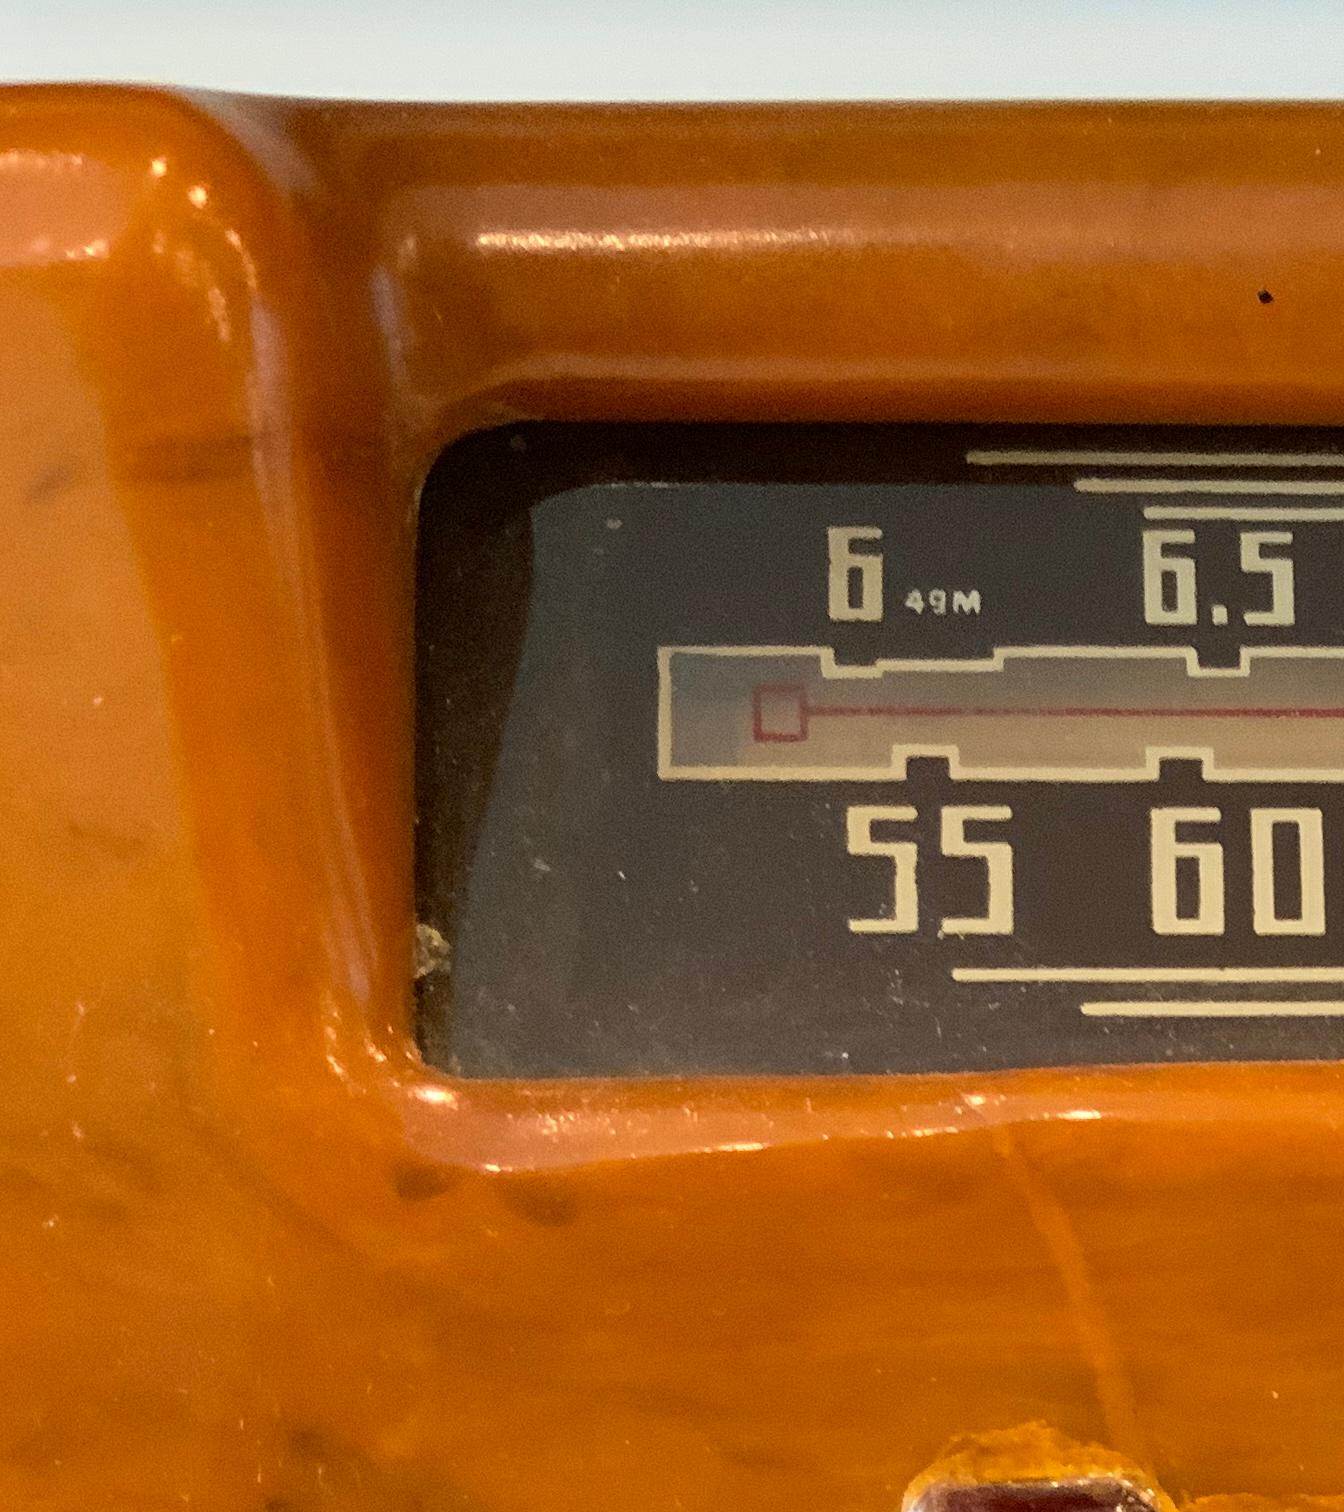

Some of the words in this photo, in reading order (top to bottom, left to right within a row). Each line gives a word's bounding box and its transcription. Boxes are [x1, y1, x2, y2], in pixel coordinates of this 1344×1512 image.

[828, 526, 884, 622] 6
[904, 588, 982, 615] 49M
[1142, 529, 1295, 626] 6.5
[846, 805, 1015, 935] 55
[1150, 806, 1326, 936] 60
